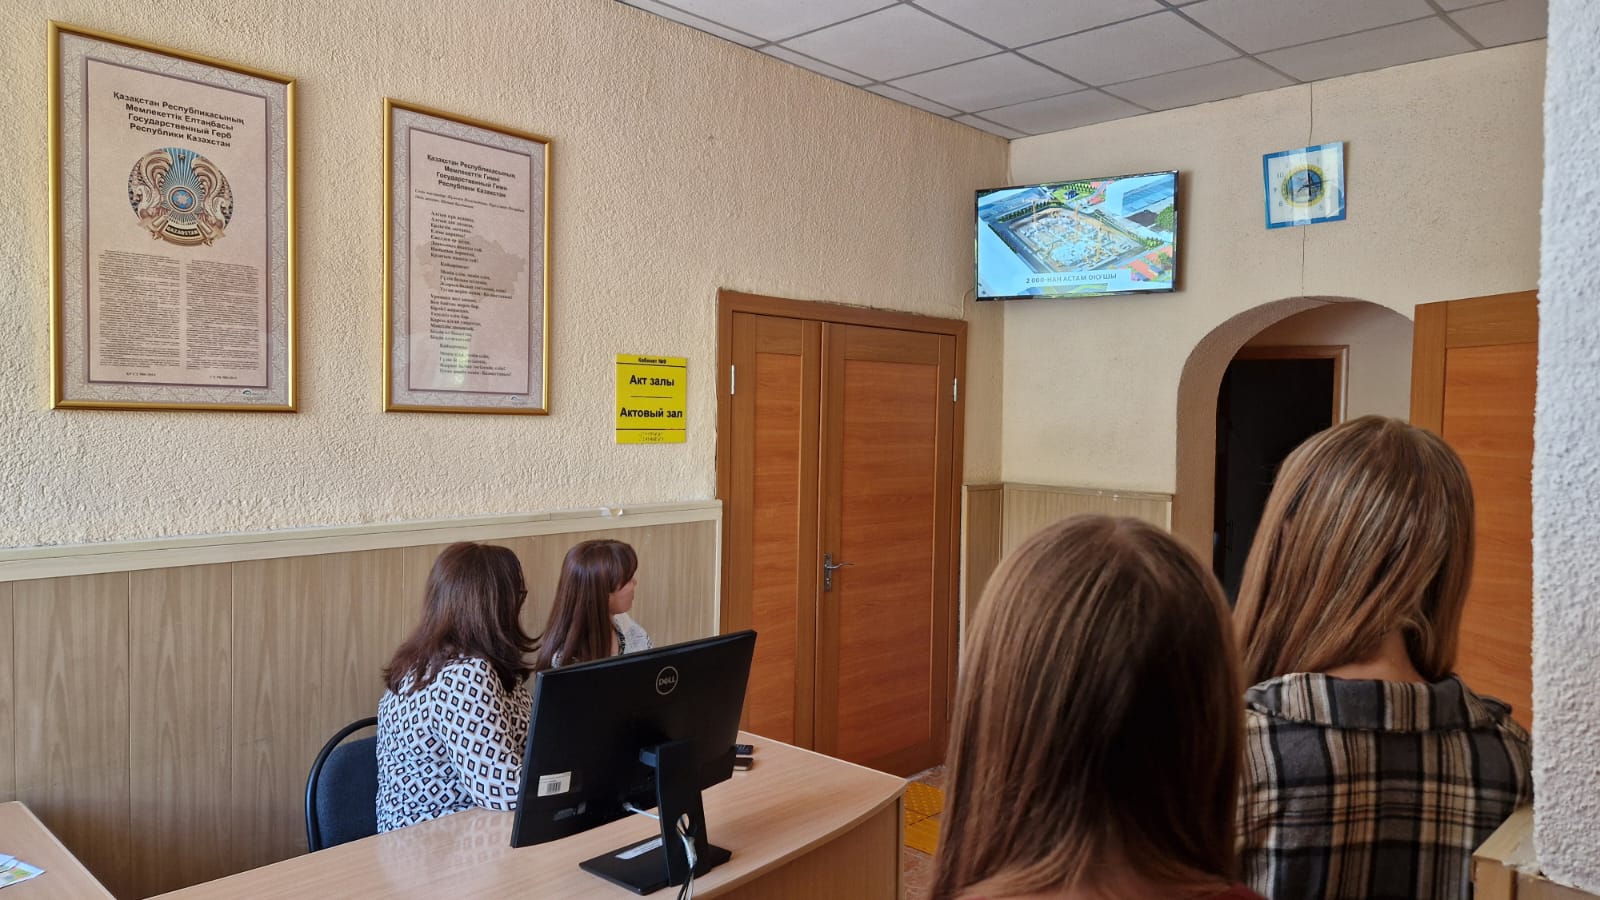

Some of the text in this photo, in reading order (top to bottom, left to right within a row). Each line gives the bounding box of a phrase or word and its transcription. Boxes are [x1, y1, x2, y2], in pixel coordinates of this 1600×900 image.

[113, 91, 245, 125] Қазақстан Республикасының
[125, 103, 234, 131] Мемлекеттік Елтаңбасы
[128, 113, 232, 140] Государственный Герб
[130, 122, 231, 148] Республики Казахстан
[629, 374, 675, 386] Акт залы
[620, 407, 683, 418] Актовый зал
[658, 675, 675, 686] DELL
